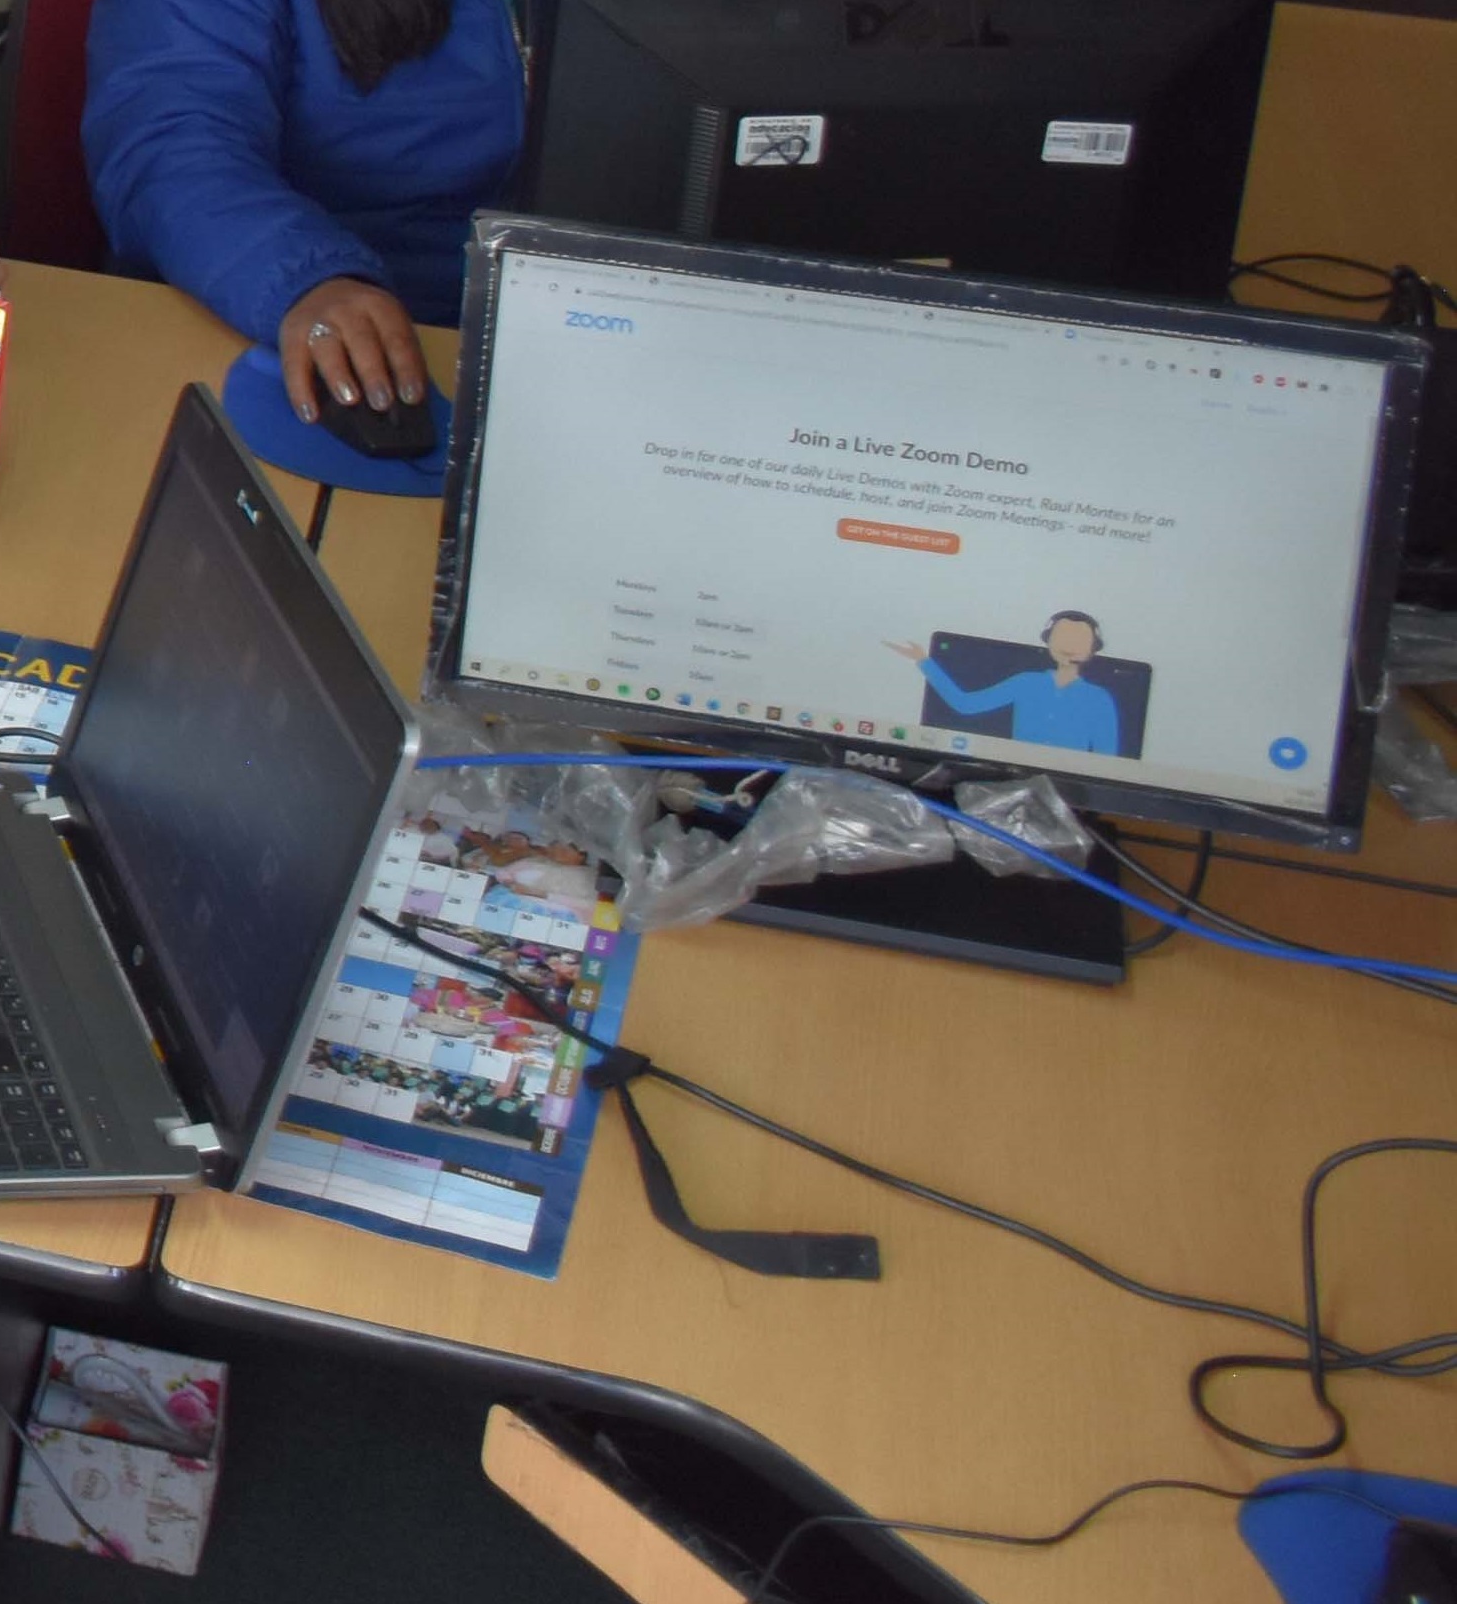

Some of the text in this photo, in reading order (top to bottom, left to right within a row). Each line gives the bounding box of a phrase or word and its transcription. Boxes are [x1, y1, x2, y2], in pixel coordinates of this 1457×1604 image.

[565, 310, 635, 334] zoom
[789, 427, 1029, 476] Join a Live Zoom Demo
[643, 441, 678, 460] Drop
[681, 445, 695, 460] in
[696, 449, 716, 464] for
[719, 454, 745, 468] one
[746, 457, 764, 473] of
[764, 461, 788, 474] our
[790, 461, 824, 480] daily
[827, 467, 855, 483] Live
[858, 471, 907, 491] Demos
[909, 479, 942, 496] with
[944, 483, 984, 501] Zoom
[1131, 509, 1153, 526] for
[1155, 516, 1176, 529] an
[662, 463, 723, 483] overview
[724, 471, 741, 486] of
[743, 473, 771, 489] how
[775, 479, 791, 492] to
[896, 496, 924, 511] and
[925, 499, 953, 516] join
[955, 504, 997, 522] Zoom
[1078, 523, 1106, 537] and
[843, 749, 903, 774] DELL
[459, 1166, 517, 1188] DICIEMBRE
